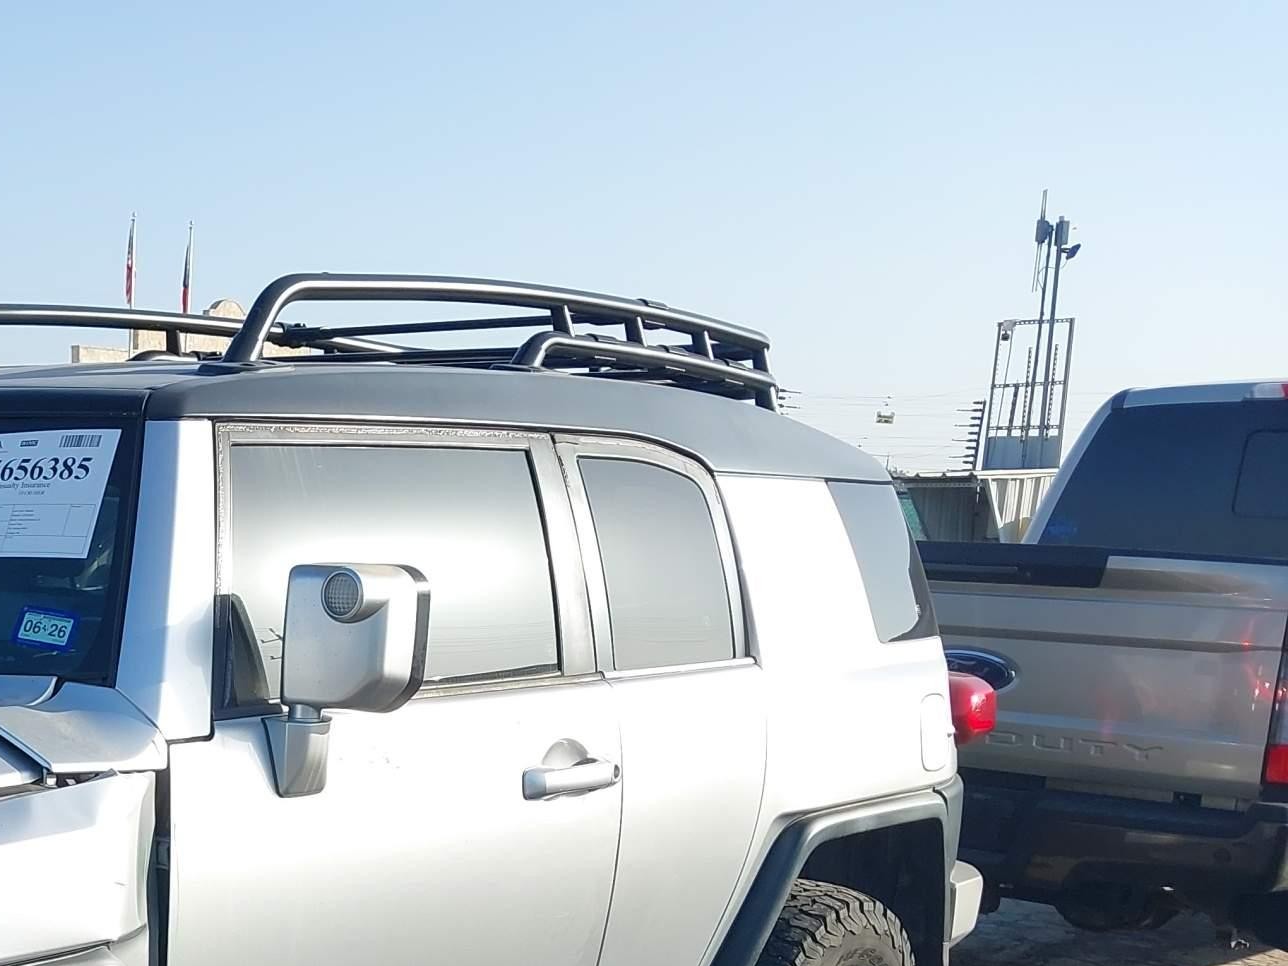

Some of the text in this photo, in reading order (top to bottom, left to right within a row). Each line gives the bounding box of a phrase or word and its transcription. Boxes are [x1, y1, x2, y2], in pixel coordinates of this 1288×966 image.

[20, 481, 52, 490] Insurance
[23, 619, 68, 639] 06 26
[985, 730, 1164, 761] DUTY
